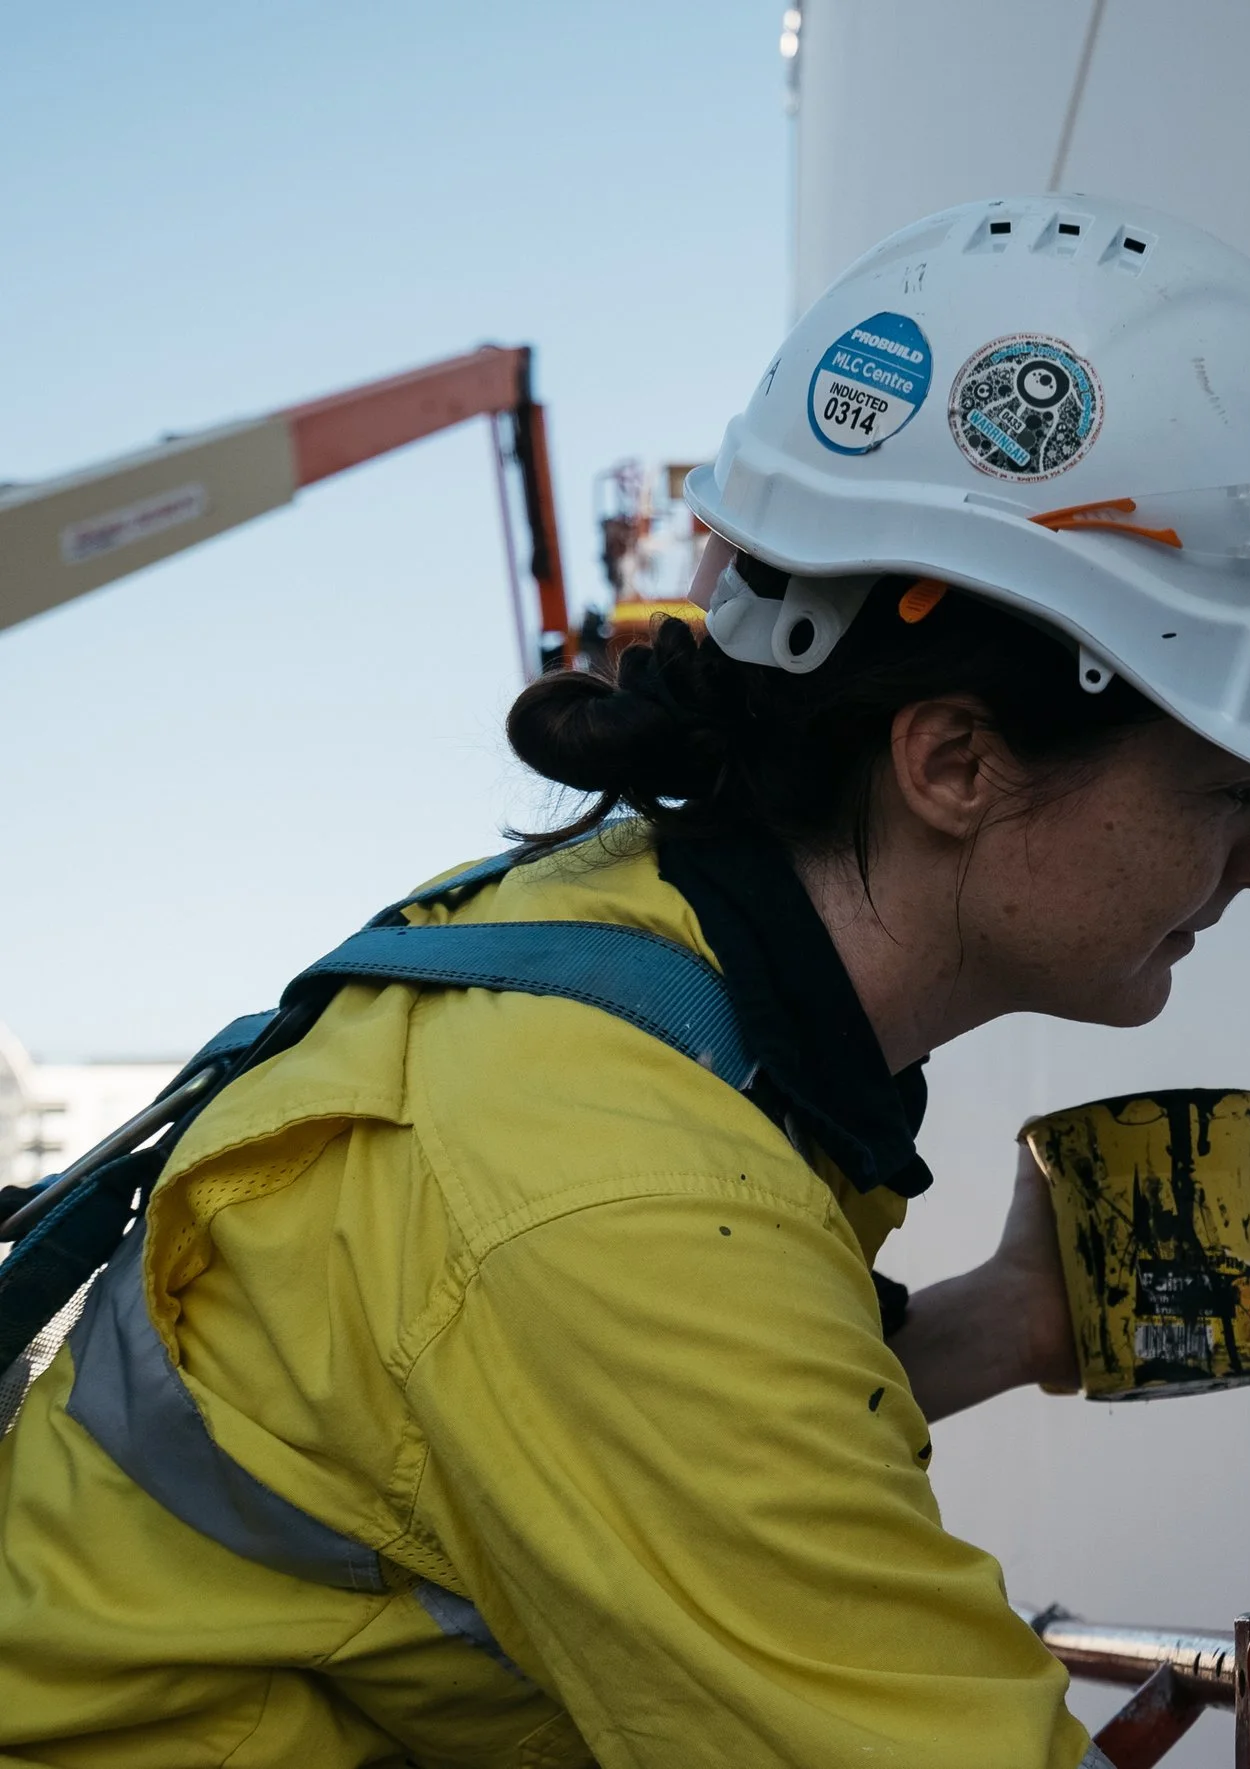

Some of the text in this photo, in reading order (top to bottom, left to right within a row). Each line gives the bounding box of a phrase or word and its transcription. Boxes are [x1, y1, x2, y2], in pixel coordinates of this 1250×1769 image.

[851, 329, 924, 364] PROBUILD
[832, 351, 914, 394] MLC Centre
[830, 381, 889, 413] INDUCTED
[823, 397, 877, 435] 0314
[1001, 411, 1022, 431] 0433
[969, 410, 1029, 465] WARRINGAH
